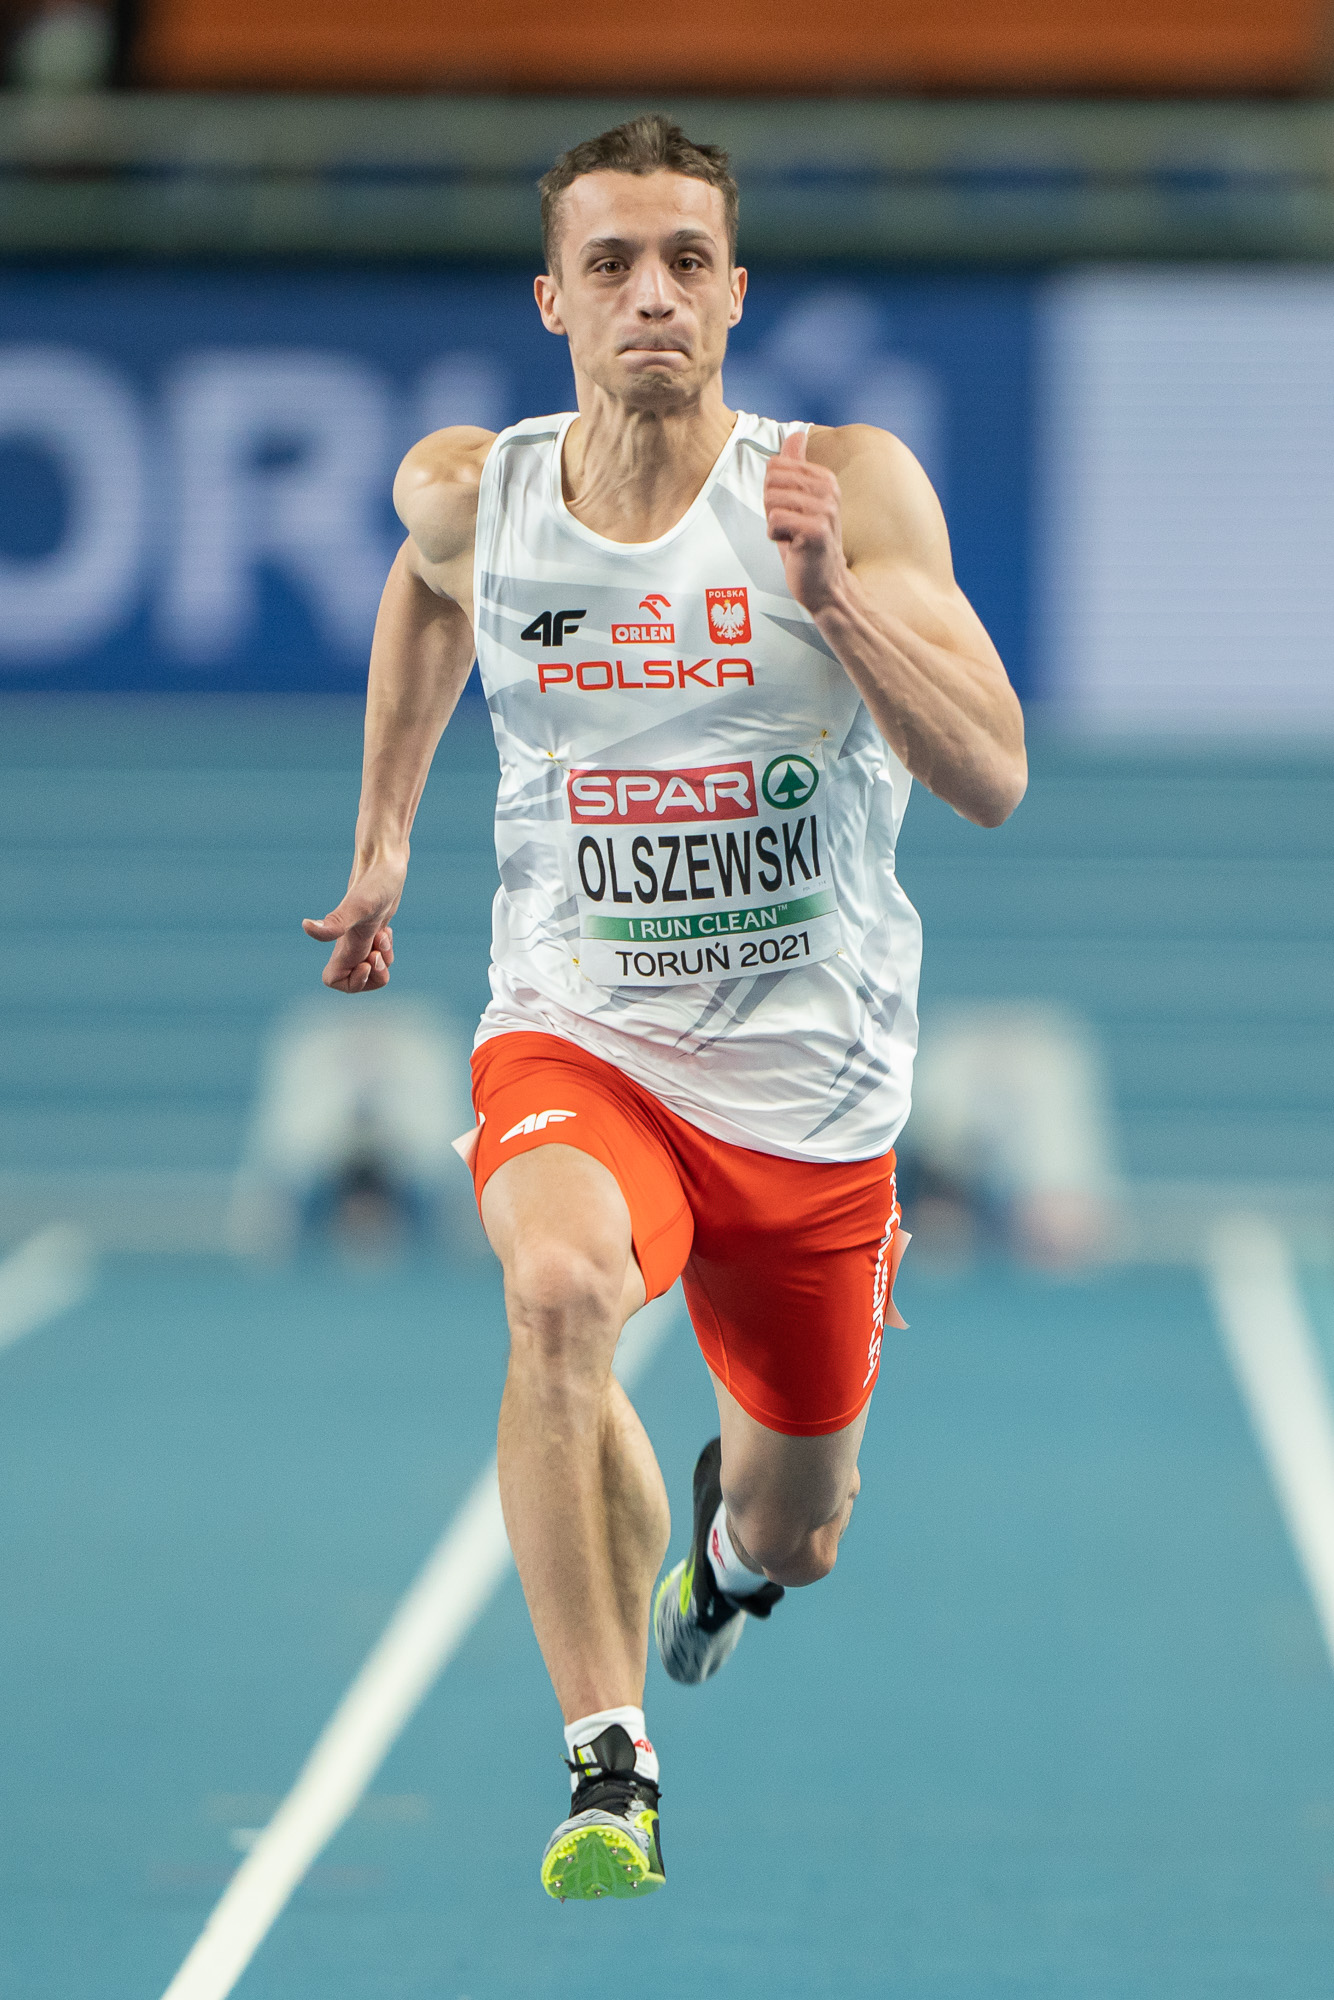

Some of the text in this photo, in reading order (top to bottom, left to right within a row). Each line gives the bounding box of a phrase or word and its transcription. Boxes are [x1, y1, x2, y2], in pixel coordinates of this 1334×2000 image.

[708, 589, 745, 598] POLSKA
[520, 609, 587, 647] 4F
[615, 625, 672, 642] ORLEN
[537, 657, 755, 694] POLSKA
[571, 771, 752, 816] SPAR
[577, 814, 822, 904] OLSZEWSKI
[627, 921, 635, 939] I
[640, 918, 692, 938] RUN
[615, 931, 811, 978] TORUŃ 2021
